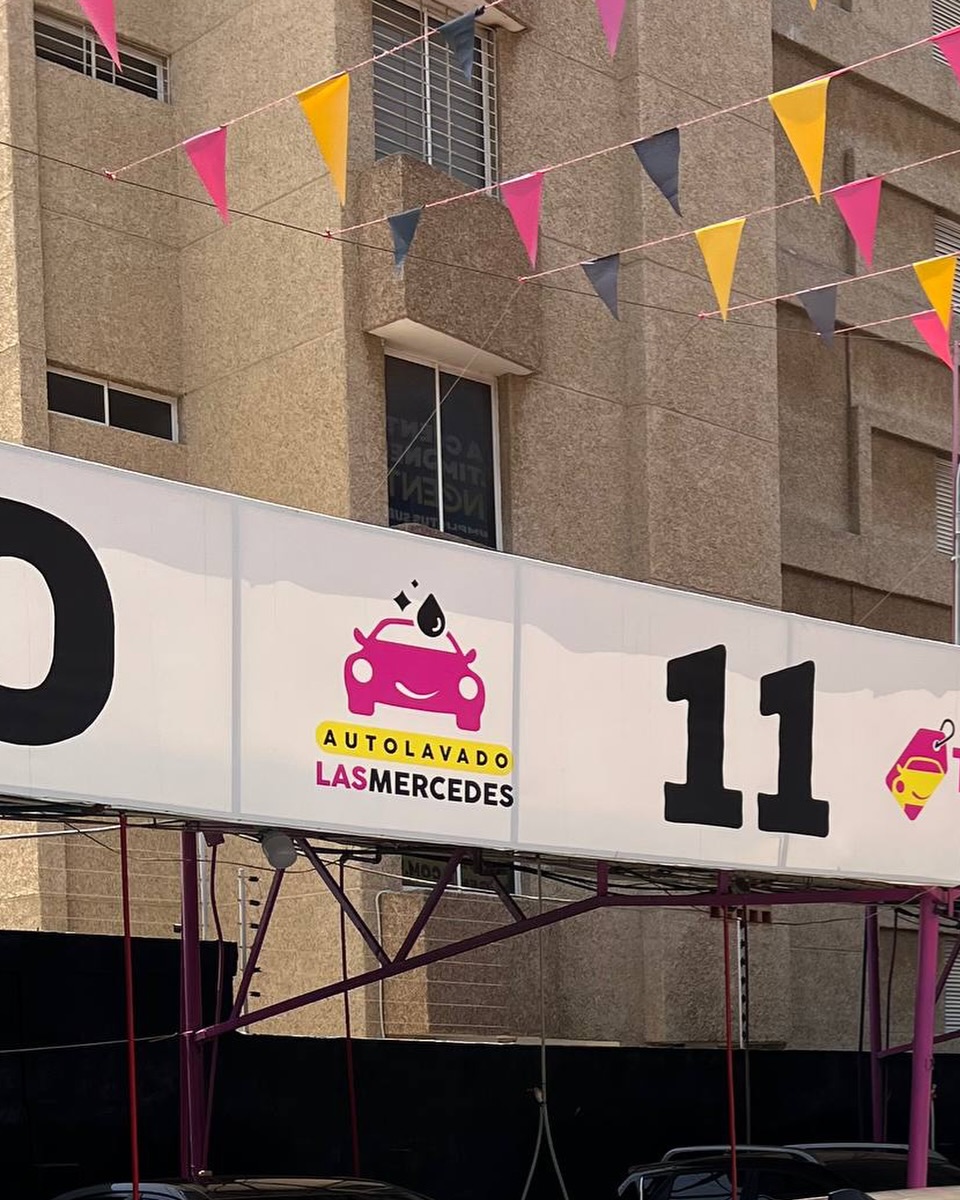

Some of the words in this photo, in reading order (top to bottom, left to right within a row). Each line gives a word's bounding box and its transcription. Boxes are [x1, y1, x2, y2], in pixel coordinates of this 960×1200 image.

[323, 729, 508, 768] AUTOLAVADO
[664, 645, 829, 837] 11
[316, 761, 515, 808] LASMERCEDES
